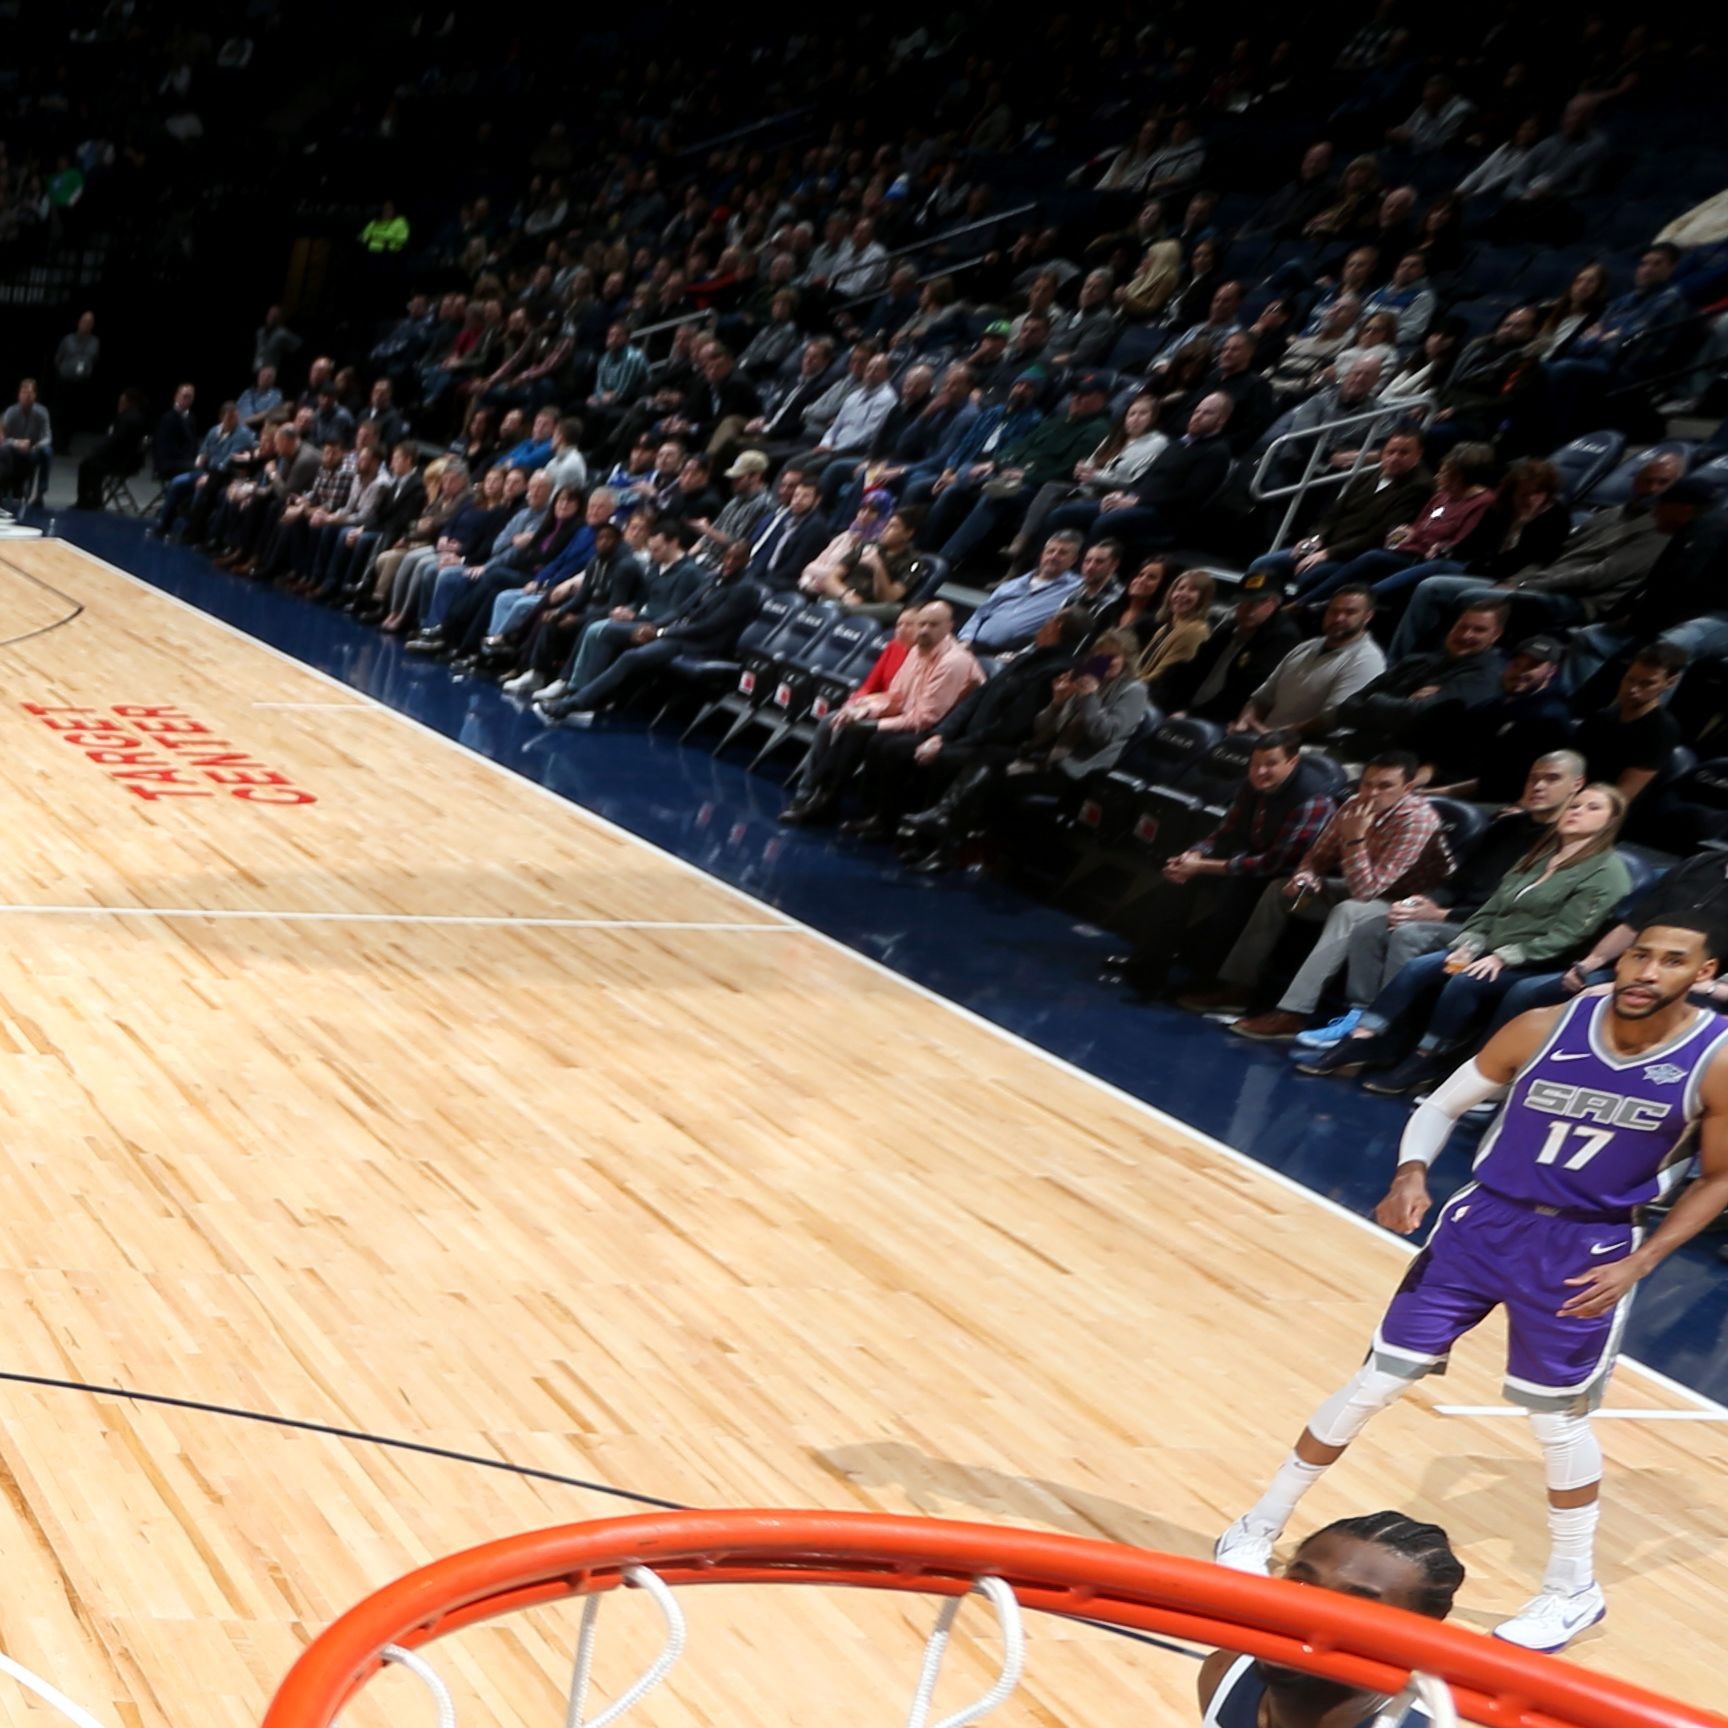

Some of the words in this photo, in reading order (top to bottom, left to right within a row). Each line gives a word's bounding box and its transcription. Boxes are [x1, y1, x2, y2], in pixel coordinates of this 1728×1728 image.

[19, 702, 214, 801] TARGET
[110, 704, 318, 806] CENTER
[1523, 1079, 1672, 1131] SAC
[1535, 1120, 1615, 1171] 17
